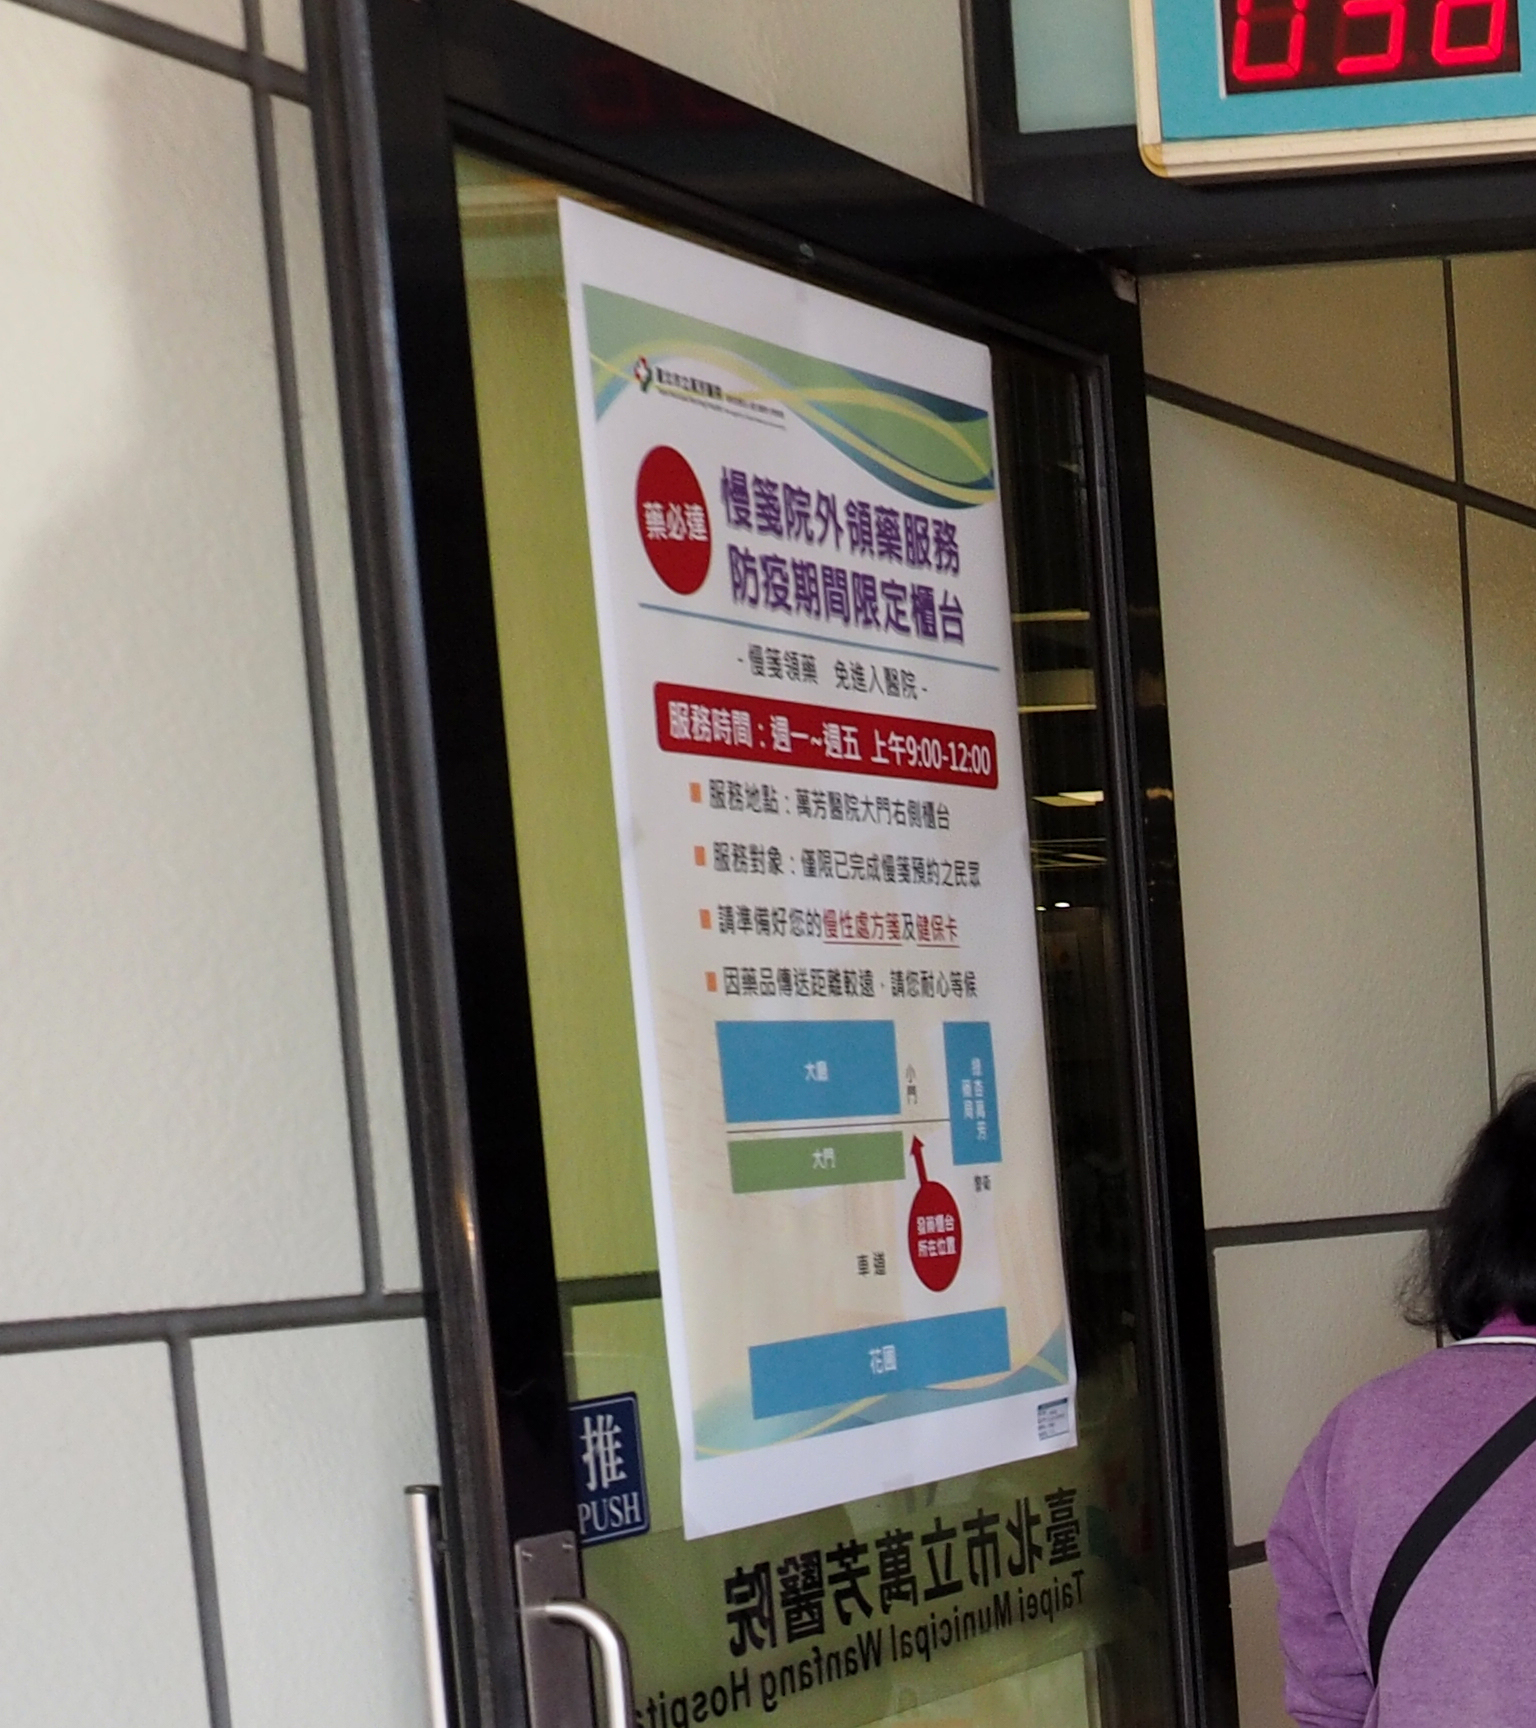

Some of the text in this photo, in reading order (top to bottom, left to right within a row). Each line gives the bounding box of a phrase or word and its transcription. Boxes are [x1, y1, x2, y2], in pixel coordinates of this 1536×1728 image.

[642, 501, 709, 543] 藥必達
[720, 465, 960, 577] 慢箋院外領藥服務
[727, 543, 965, 645] 防疫期間限定櫃台
[748, 643, 918, 700] 慢箋領藥 免進入醫院
[668, 701, 991, 776] 服務時間：週一~週五 上午9:00-12:00
[812, 1147, 836, 1170] 大門
[869, 1344, 898, 1375] 花圃
[580, 1412, 627, 1492] 推
[578, 1491, 643, 1535] PUSH
